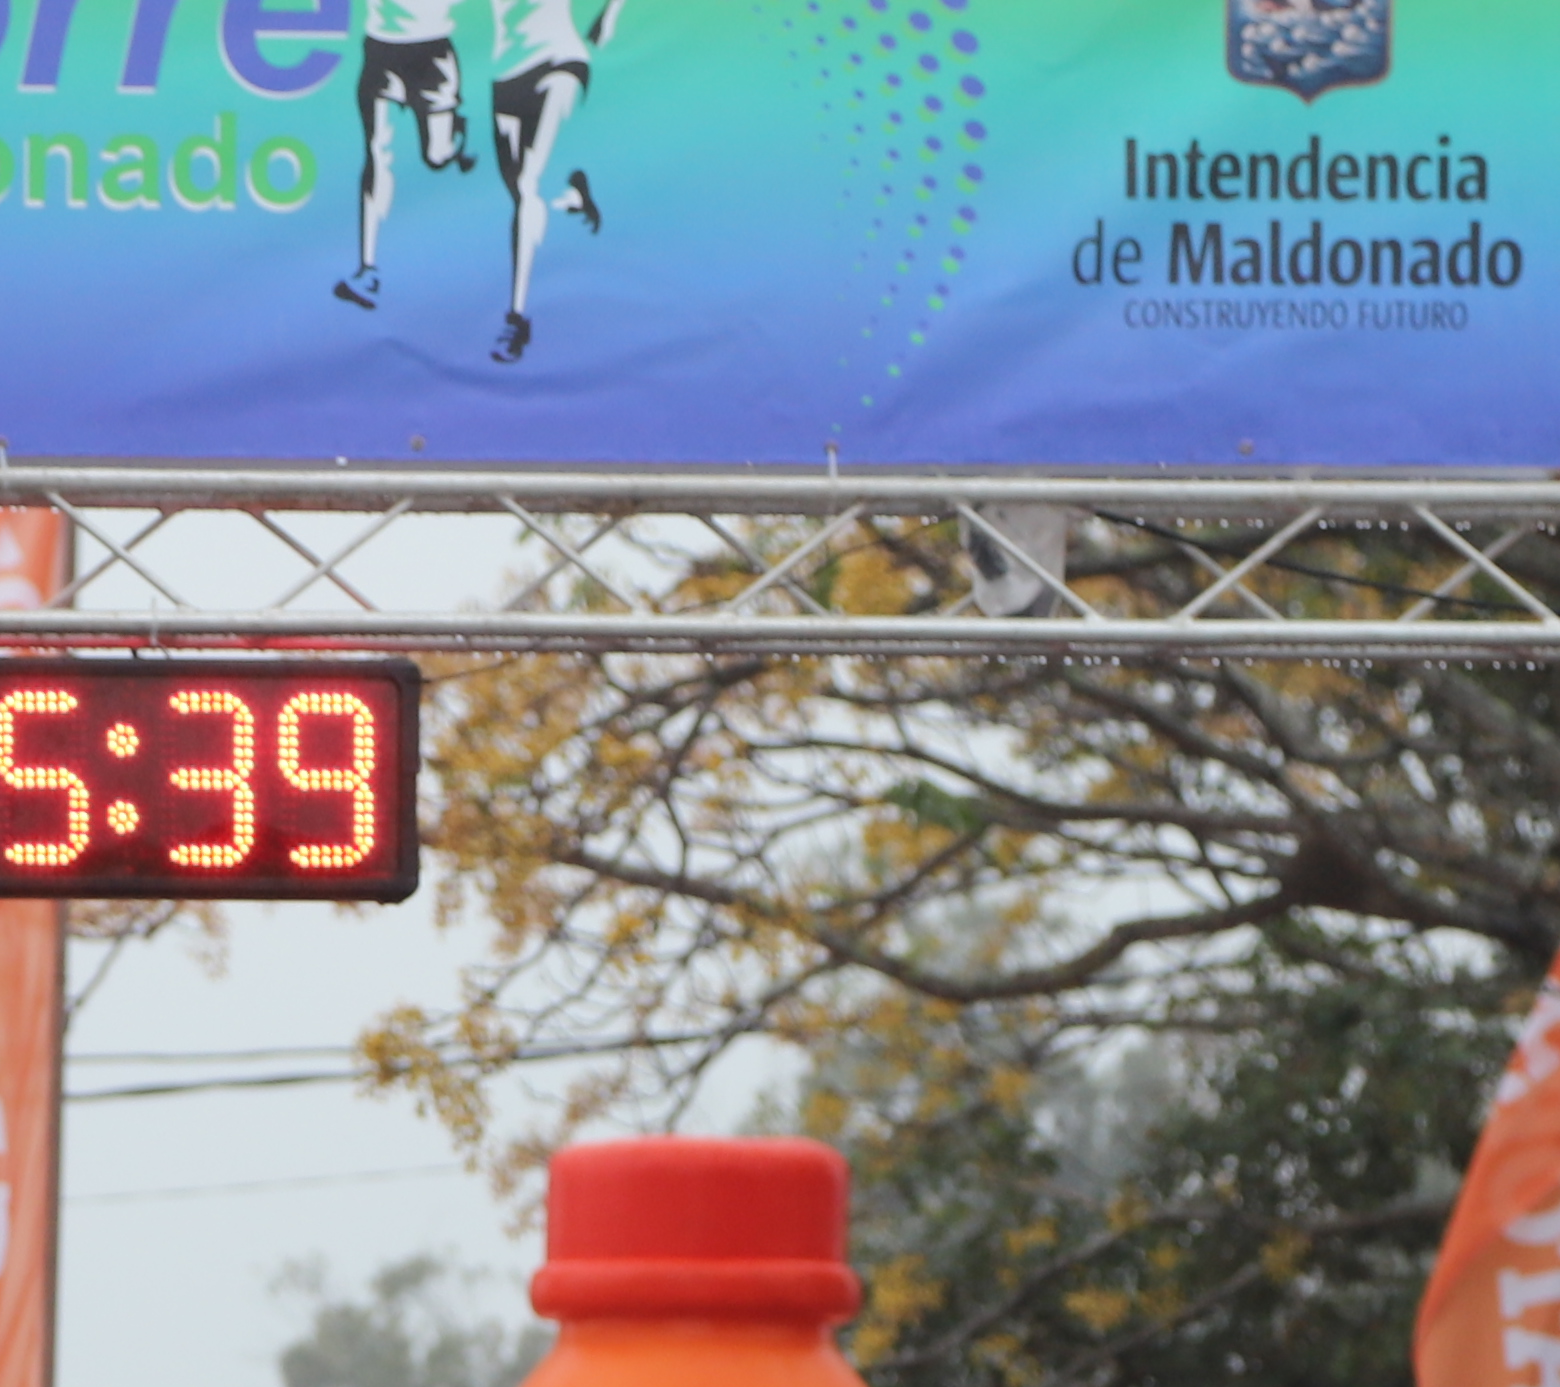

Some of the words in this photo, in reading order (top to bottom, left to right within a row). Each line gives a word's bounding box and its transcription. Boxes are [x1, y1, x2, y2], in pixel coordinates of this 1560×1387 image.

[1124, 135, 1489, 201] Intendencia
[1072, 219, 1142, 286] de
[1168, 220, 1524, 289] Maldonado
[1124, 300, 1350, 331] CONSTRUYENDO
[1358, 302, 1470, 332] FUTURO
